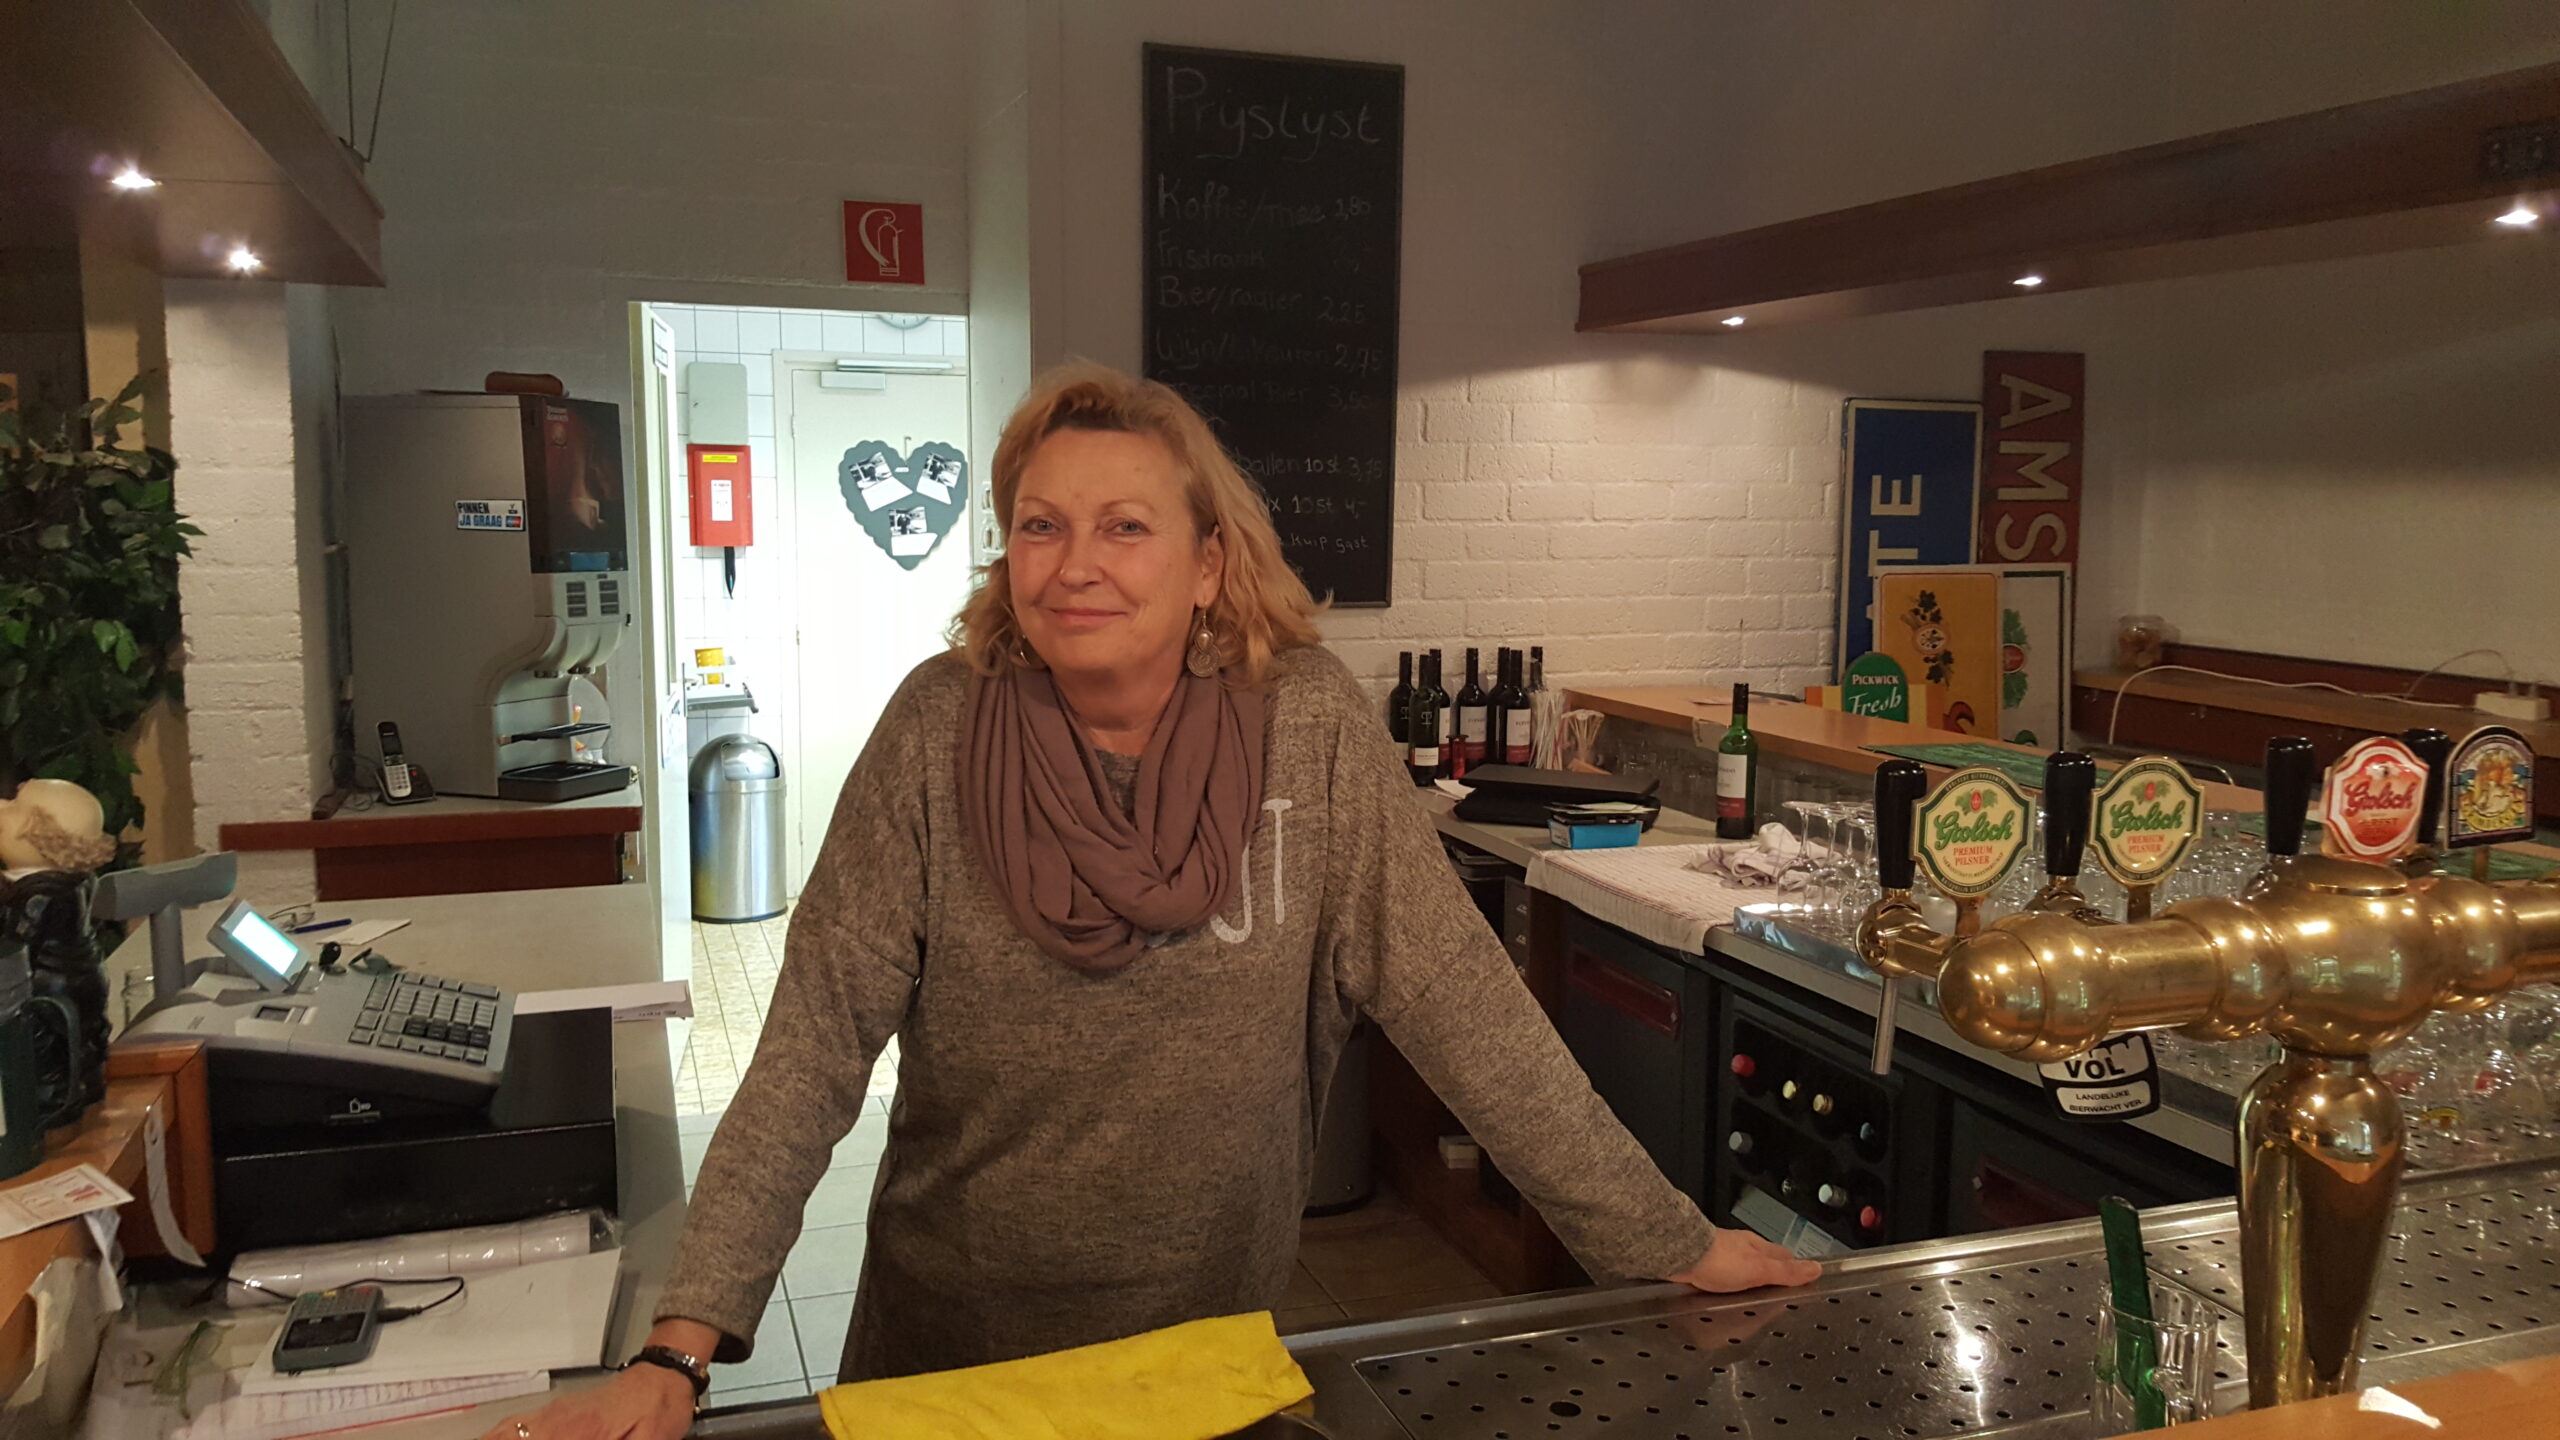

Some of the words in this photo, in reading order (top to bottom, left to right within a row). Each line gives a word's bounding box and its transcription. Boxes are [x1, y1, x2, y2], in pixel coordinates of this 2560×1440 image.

[457, 502, 490, 513] PINNEN
[460, 514, 471, 526] JA
[473, 514, 502, 527] GRAAG
[1848, 686, 1902, 716] Fresh
[2343, 780, 2418, 817] Grolsch
[2109, 800, 2186, 839] Grolsch
[1933, 810, 2016, 851] Grolsch
[1953, 846, 1993, 856] PREMIUM
[1954, 856, 1990, 866] PILSNER
[2064, 1057, 2126, 1079] VOL
[2069, 1104, 2122, 1113] BIERWACHT
